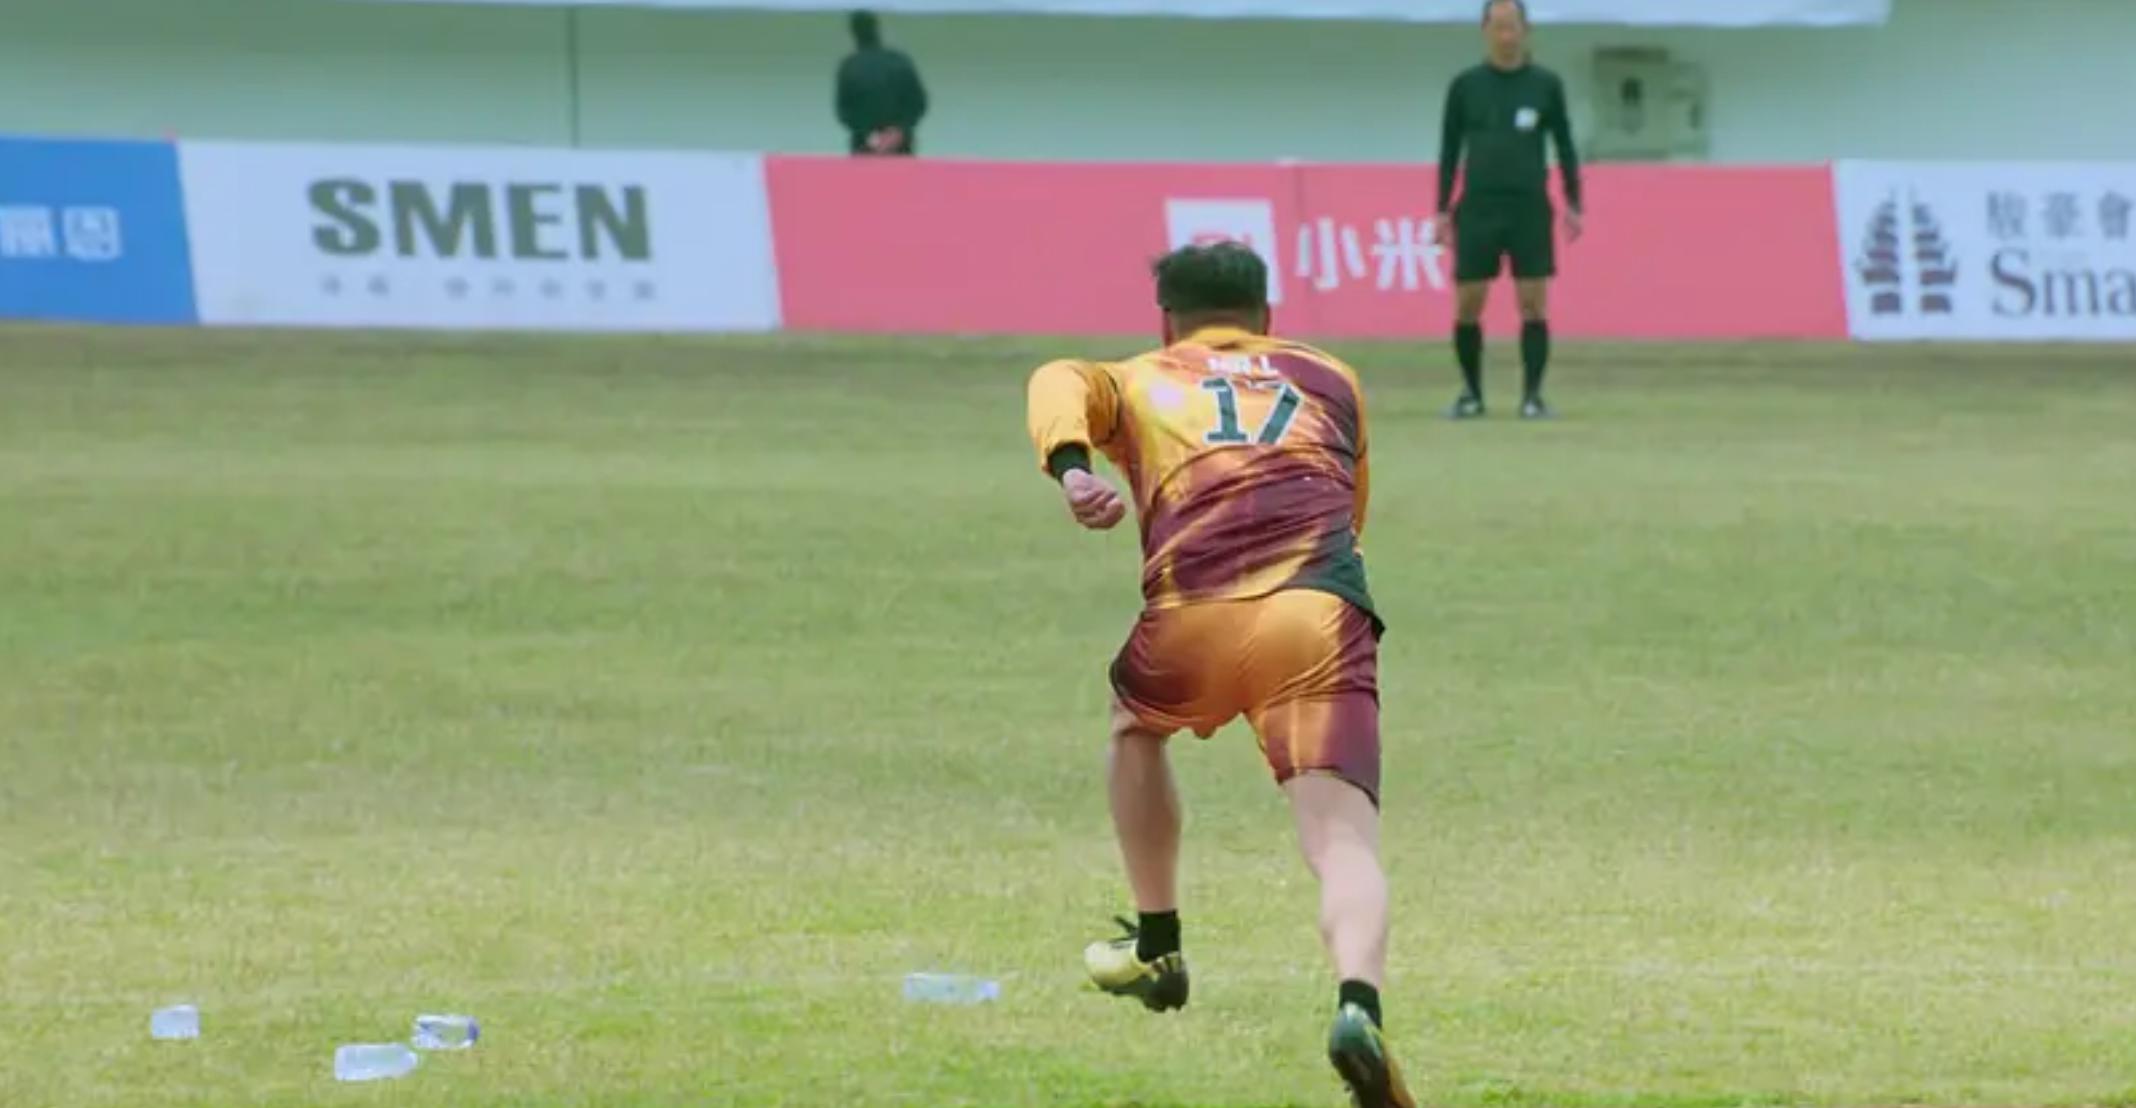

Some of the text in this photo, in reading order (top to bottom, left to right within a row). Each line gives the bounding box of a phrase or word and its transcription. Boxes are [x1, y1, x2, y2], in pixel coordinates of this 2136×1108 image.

[307, 178, 652, 261] SMEN
[1295, 217, 1446, 291] 小米
[1989, 247, 2136, 318] Sma
[1201, 377, 1304, 445] 17
